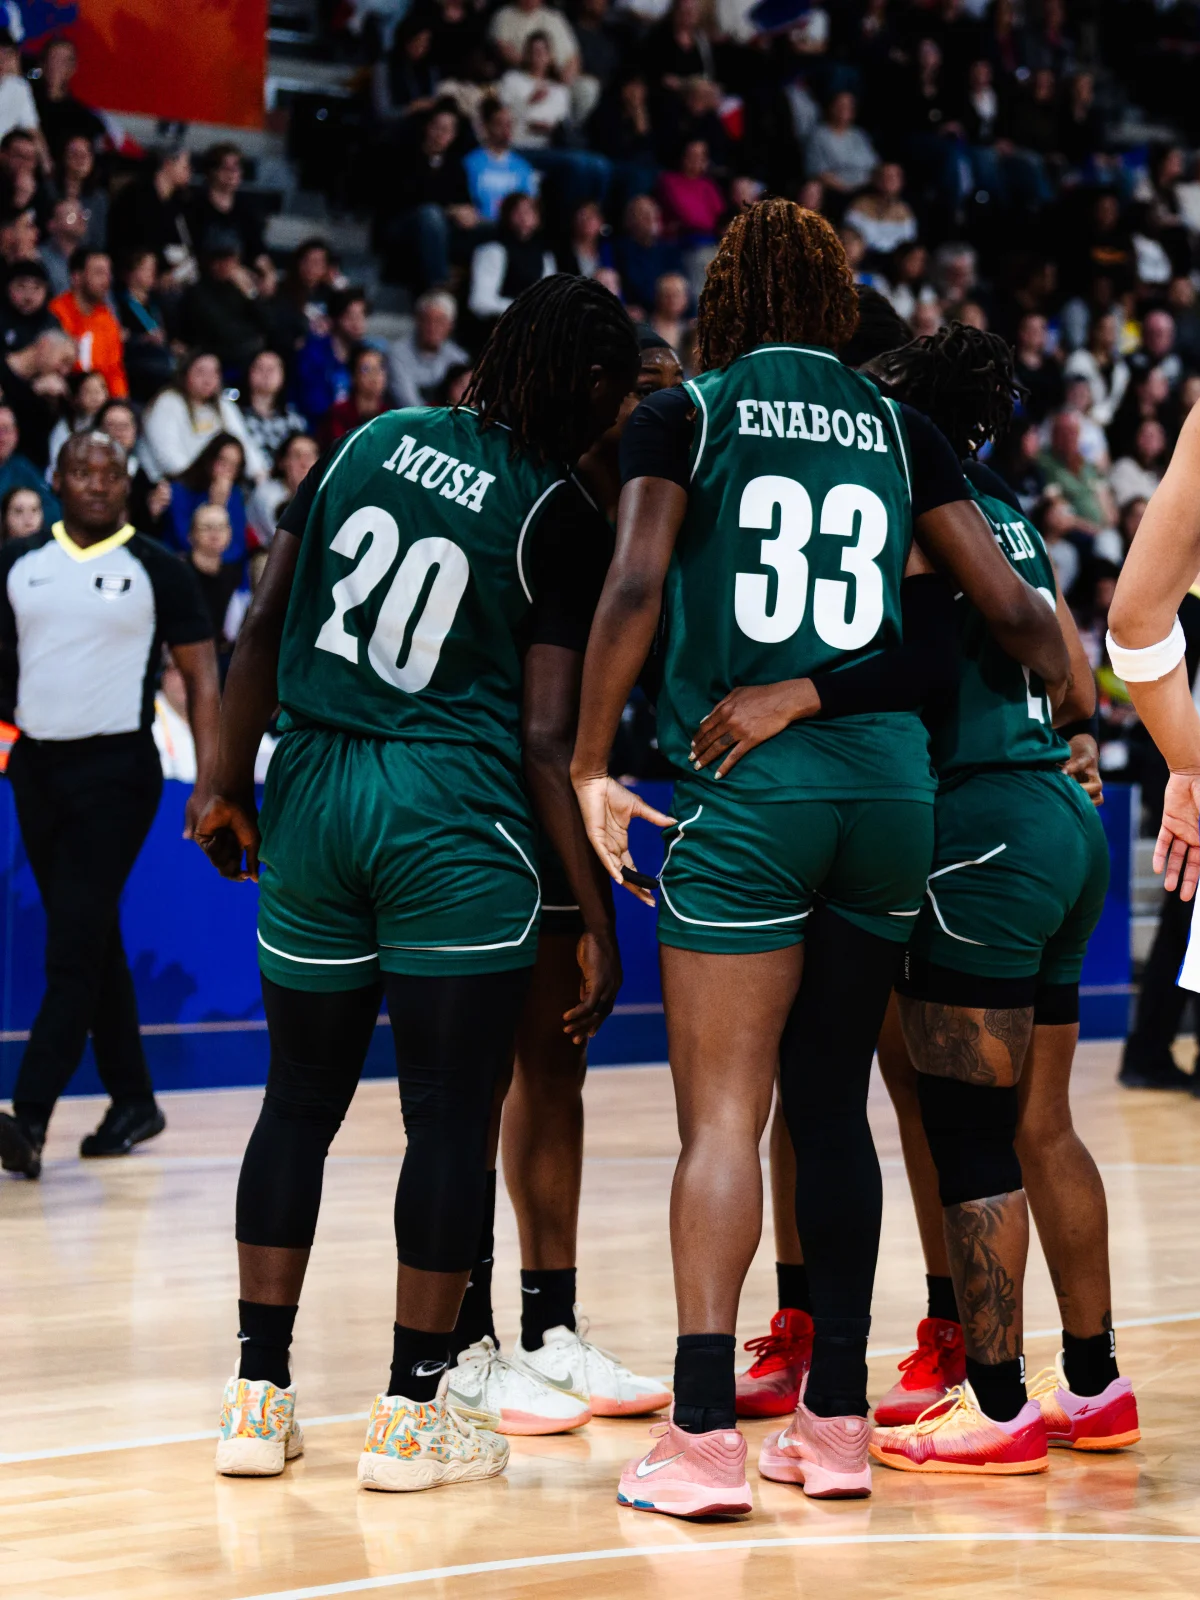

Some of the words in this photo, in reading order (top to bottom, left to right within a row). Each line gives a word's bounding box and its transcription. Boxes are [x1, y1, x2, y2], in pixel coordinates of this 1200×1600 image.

[382, 434, 497, 513] MUSA
[737, 399, 888, 453] ENABOSI
[314, 505, 470, 694] 20
[734, 474, 889, 651] 33
